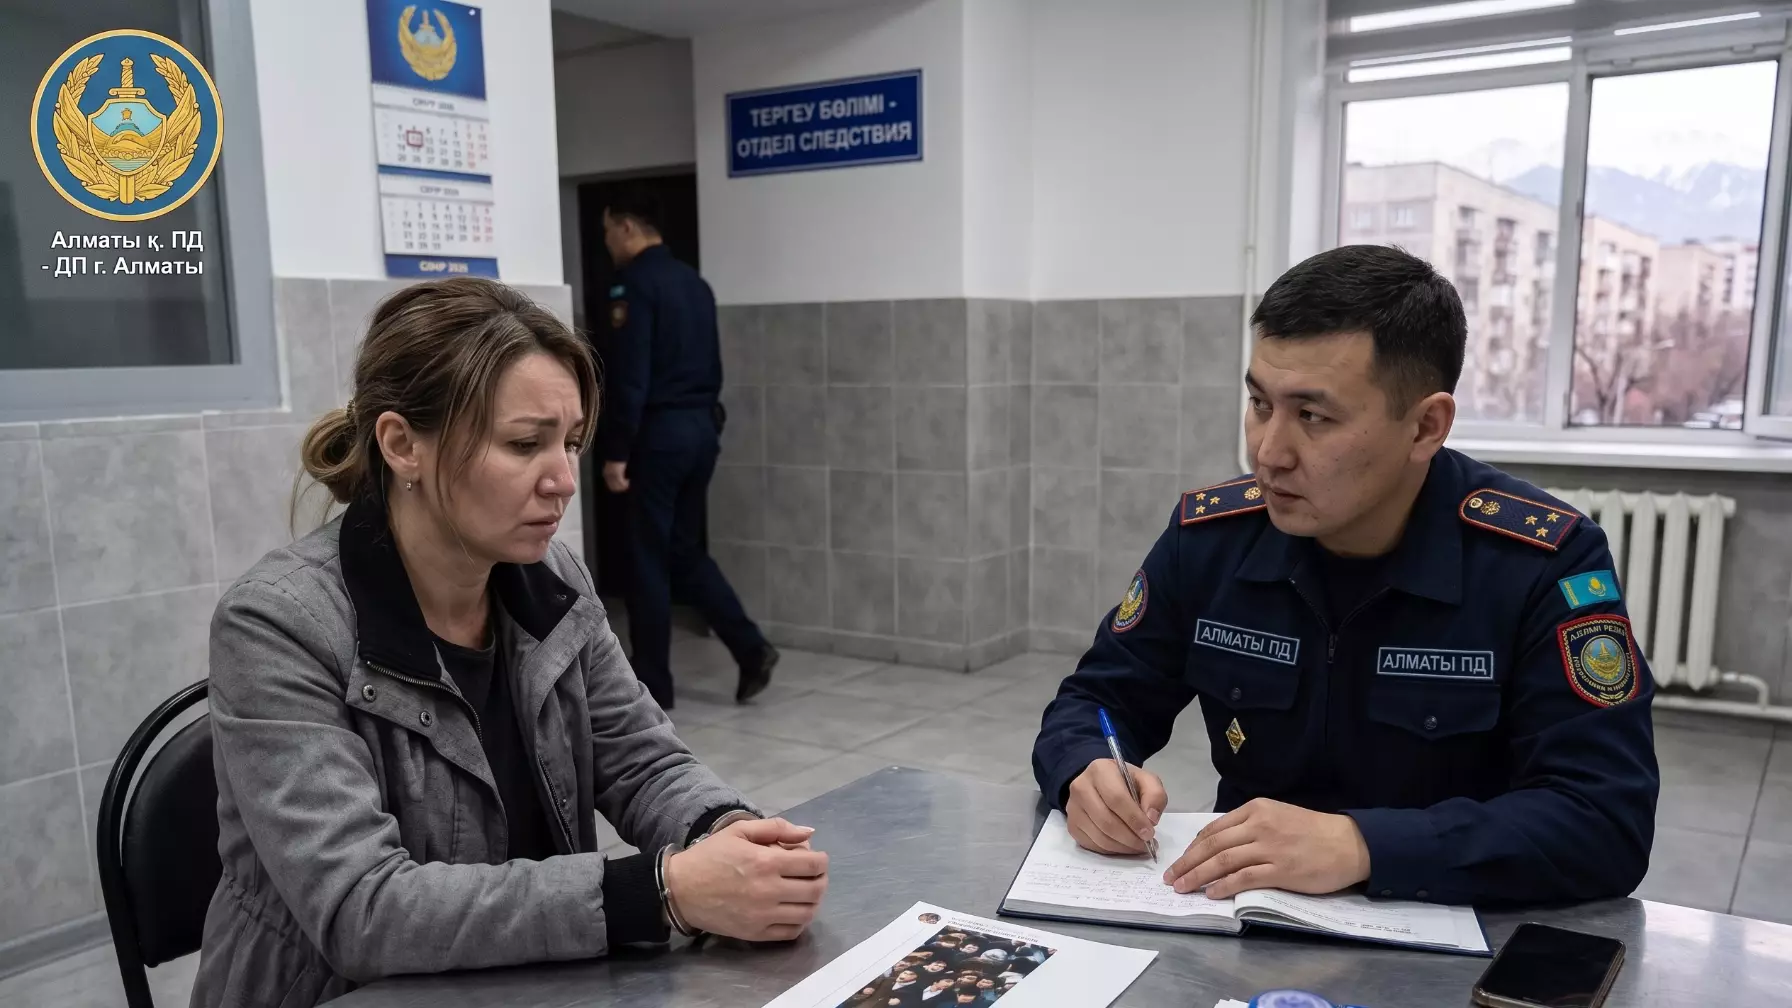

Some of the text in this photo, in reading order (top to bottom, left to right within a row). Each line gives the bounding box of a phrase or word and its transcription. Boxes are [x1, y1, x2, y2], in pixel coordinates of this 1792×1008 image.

[750, 102, 815, 127] ТЕРГЕУ
[737, 121, 912, 159] ОТДЕЛ СЛЕДСТВИЯ
[1201, 626, 1291, 660] АЛМАТЫ ПД
[1383, 653, 1487, 675] АЛМАТЫ ПД
